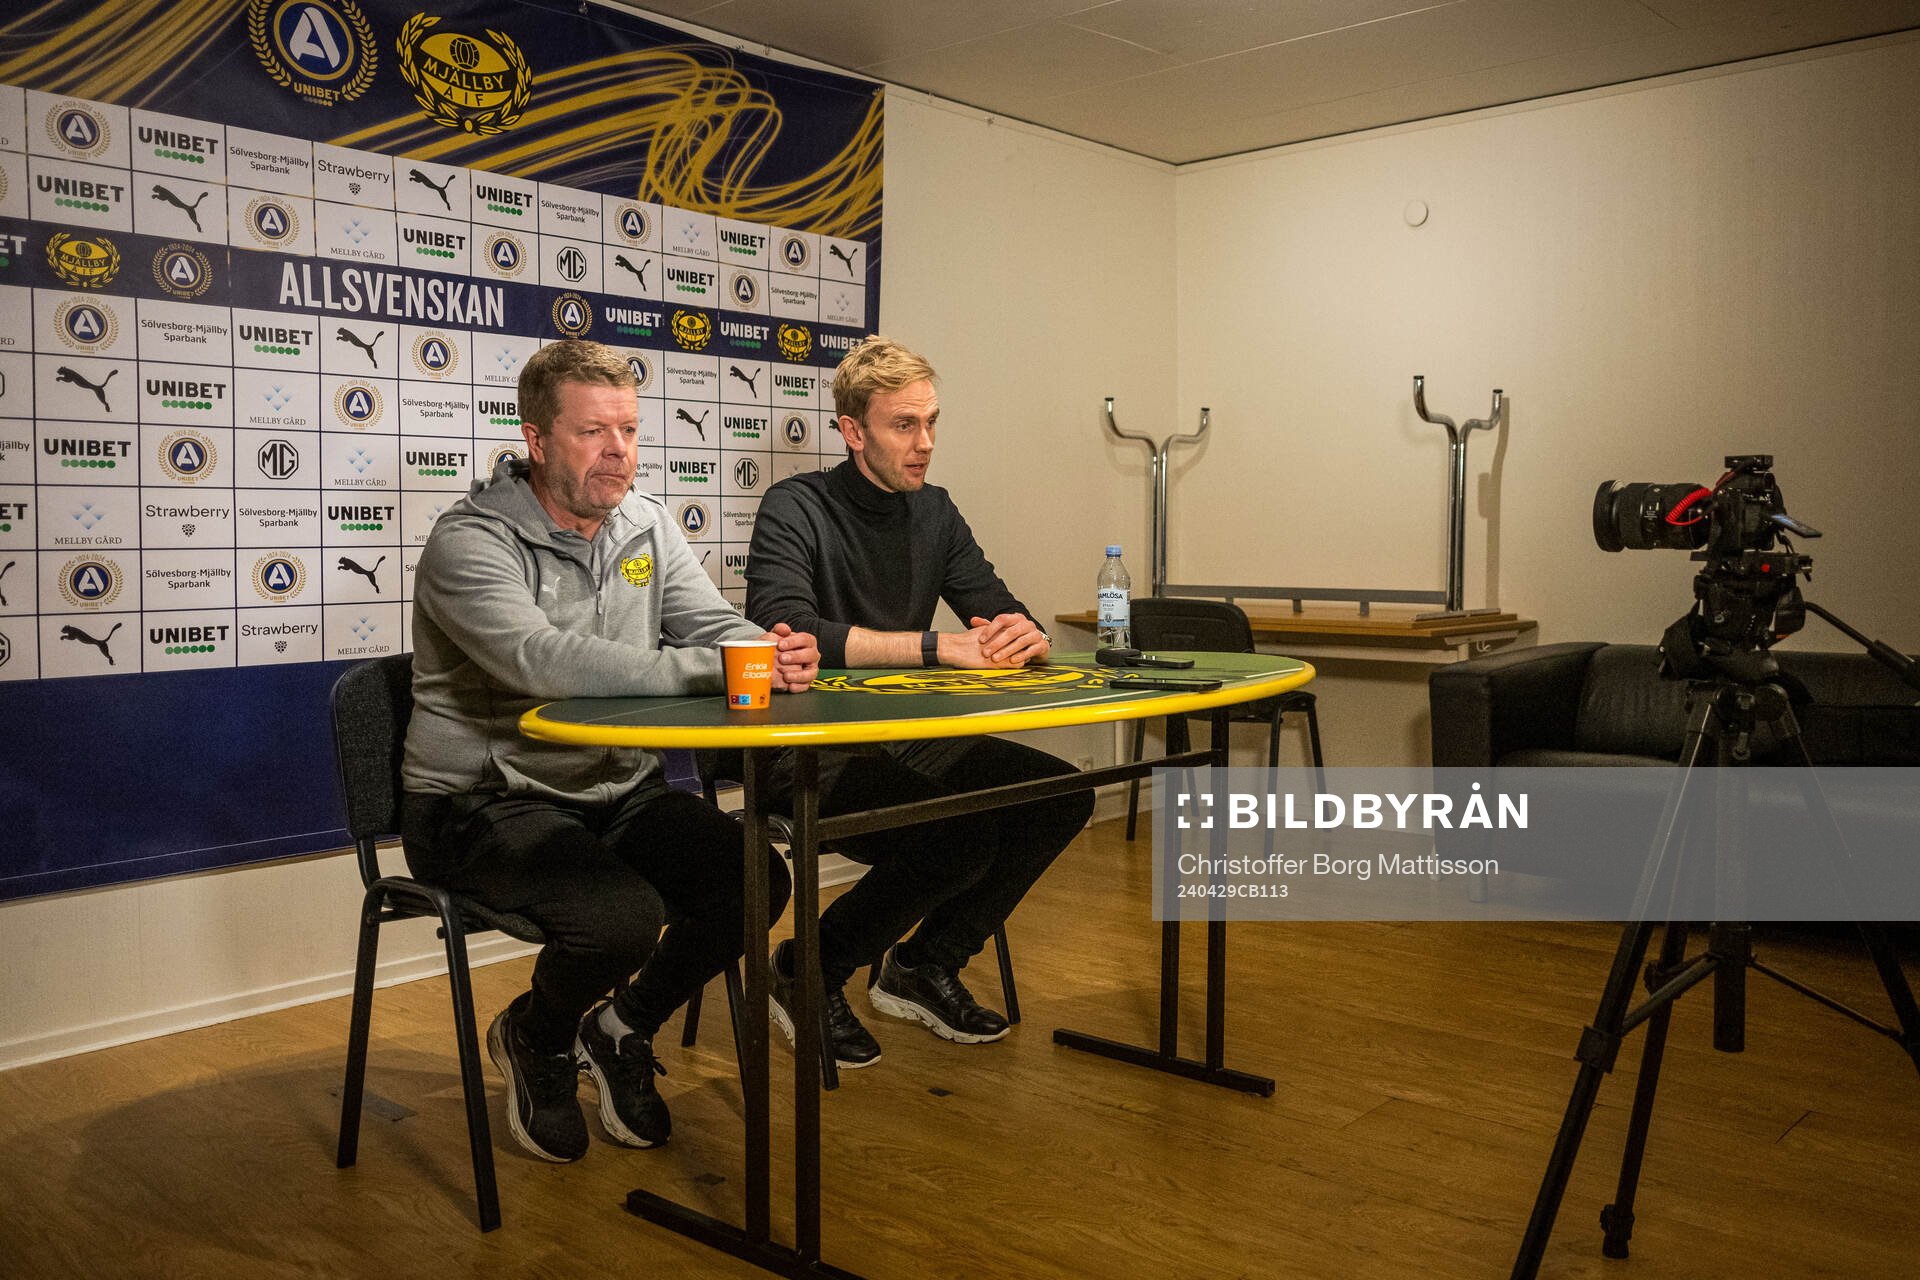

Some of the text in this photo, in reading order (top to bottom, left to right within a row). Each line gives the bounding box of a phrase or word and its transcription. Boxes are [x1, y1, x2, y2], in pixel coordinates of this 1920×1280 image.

[289, 7, 341, 69] A
[423, 57, 504, 92] MJÄLLBY
[293, 83, 341, 102] UNIBET
[65, 114, 91, 143] A
[139, 127, 218, 157] UNIBET
[230, 147, 309, 168] Sölvesborg-Mjällby
[250, 161, 290, 175] Sparbank
[318, 159, 390, 183] Strawberry
[37, 174, 124, 203] UNIBET
[477, 185, 532, 207] UNIBET
[541, 200, 599, 218] Sölvesborg-Mjällby
[556, 212, 585, 223] Sparbank
[261, 208, 283, 233] A
[626, 212, 641, 234] A
[404, 228, 465, 250] UNIBET
[721, 230, 765, 248] UNIBET
[61, 253, 105, 268] MJÄLLBY
[330, 247, 385, 260] MELLBY GÅRD
[496, 242, 514, 269] A
[788, 242, 803, 261] A
[171, 256, 195, 283] A
[559, 249, 584, 280] MG
[667, 268, 714, 286] UNIBET
[279, 262, 505, 328] ALLSVENSKAN
[738, 277, 751, 299] A
[74, 309, 100, 337] A
[565, 303, 581, 325] A
[606, 308, 661, 327] UNIBET
[141, 319, 228, 336] Sölvesborg-Mjällby
[240, 325, 312, 345] UNIBET
[721, 322, 769, 340] UNIBET
[163, 333, 207, 344] Sparbank
[426, 342, 445, 365] A
[484, 375, 510, 383] MELLBY
[775, 375, 815, 389] UNIBET
[147, 380, 226, 399] UNIBET
[349, 391, 371, 415] A
[402, 398, 470, 411] Sölvesborg-Mjällby
[478, 400, 516, 416] UNIB
[249, 415, 307, 426] MELLBY GÅRD
[420, 409, 454, 419] Sparbank
[725, 417, 767, 430] UNIBET
[789, 420, 802, 439] A
[44, 439, 131, 457] UNIBET
[176, 442, 199, 467] A
[260, 442, 296, 477] MG
[406, 452, 467, 466] UNIBET
[670, 461, 716, 474] UNIBET
[334, 477, 387, 487] MELLBY GÅRD
[736, 460, 757, 487] MG
[145, 504, 230, 521] Strawberry
[239, 508, 317, 518] Sölvesborg-Mjällby
[328, 506, 394, 520] UNIBET
[687, 509, 700, 528] A
[260, 518, 299, 527] Sparbank
[54, 535, 123, 545] MELLBY GÅRD
[725, 555, 748, 567] UNI
[78, 567, 104, 592] A
[145, 569, 232, 579] Sölvesborg-Mjällby
[268, 563, 290, 588] A
[168, 579, 211, 590] Sparbank
[150, 626, 229, 644] UNIBET
[241, 622, 318, 637] Strawberry
[337, 644, 390, 656] MELLBY GÅRD
